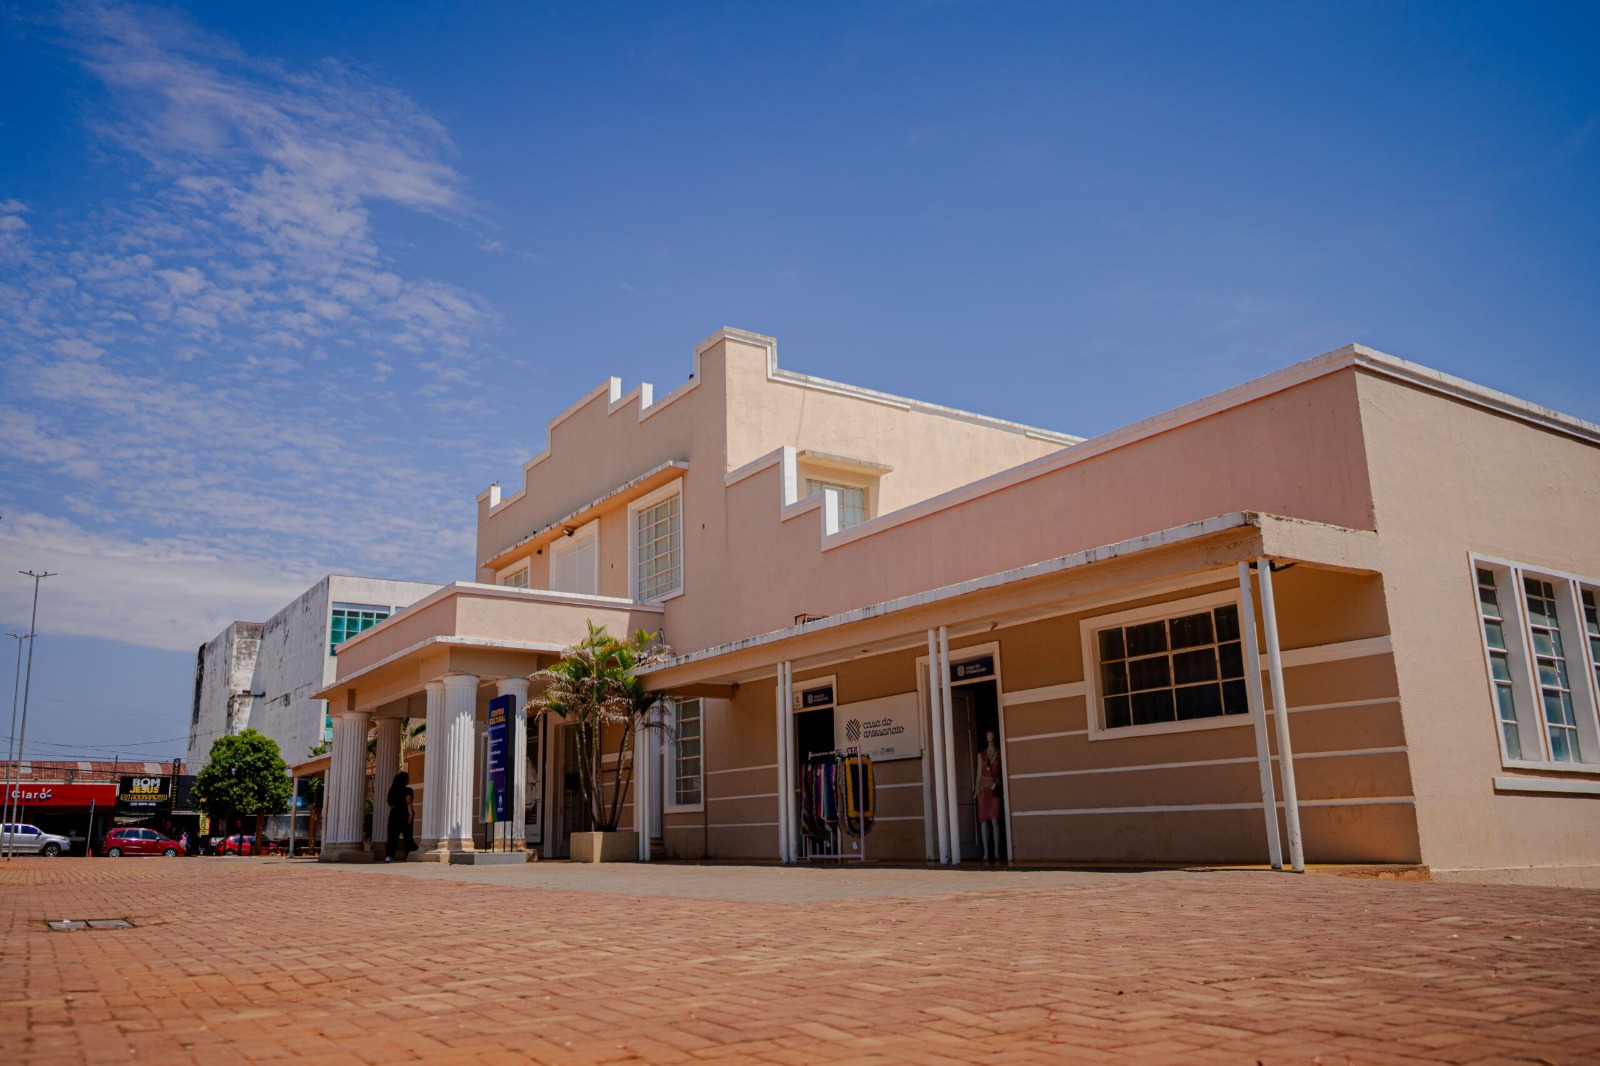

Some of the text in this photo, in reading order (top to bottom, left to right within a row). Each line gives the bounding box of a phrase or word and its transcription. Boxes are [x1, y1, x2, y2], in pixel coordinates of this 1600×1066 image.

[863, 717, 893, 729] casa do
[863, 726, 905, 739] artesanato
[132, 778, 161, 787] BOM
[11, 789, 48, 799] Claro
[129, 786, 160, 794] JESUS
[119, 793, 168, 801] ESTACIONAMENTO
